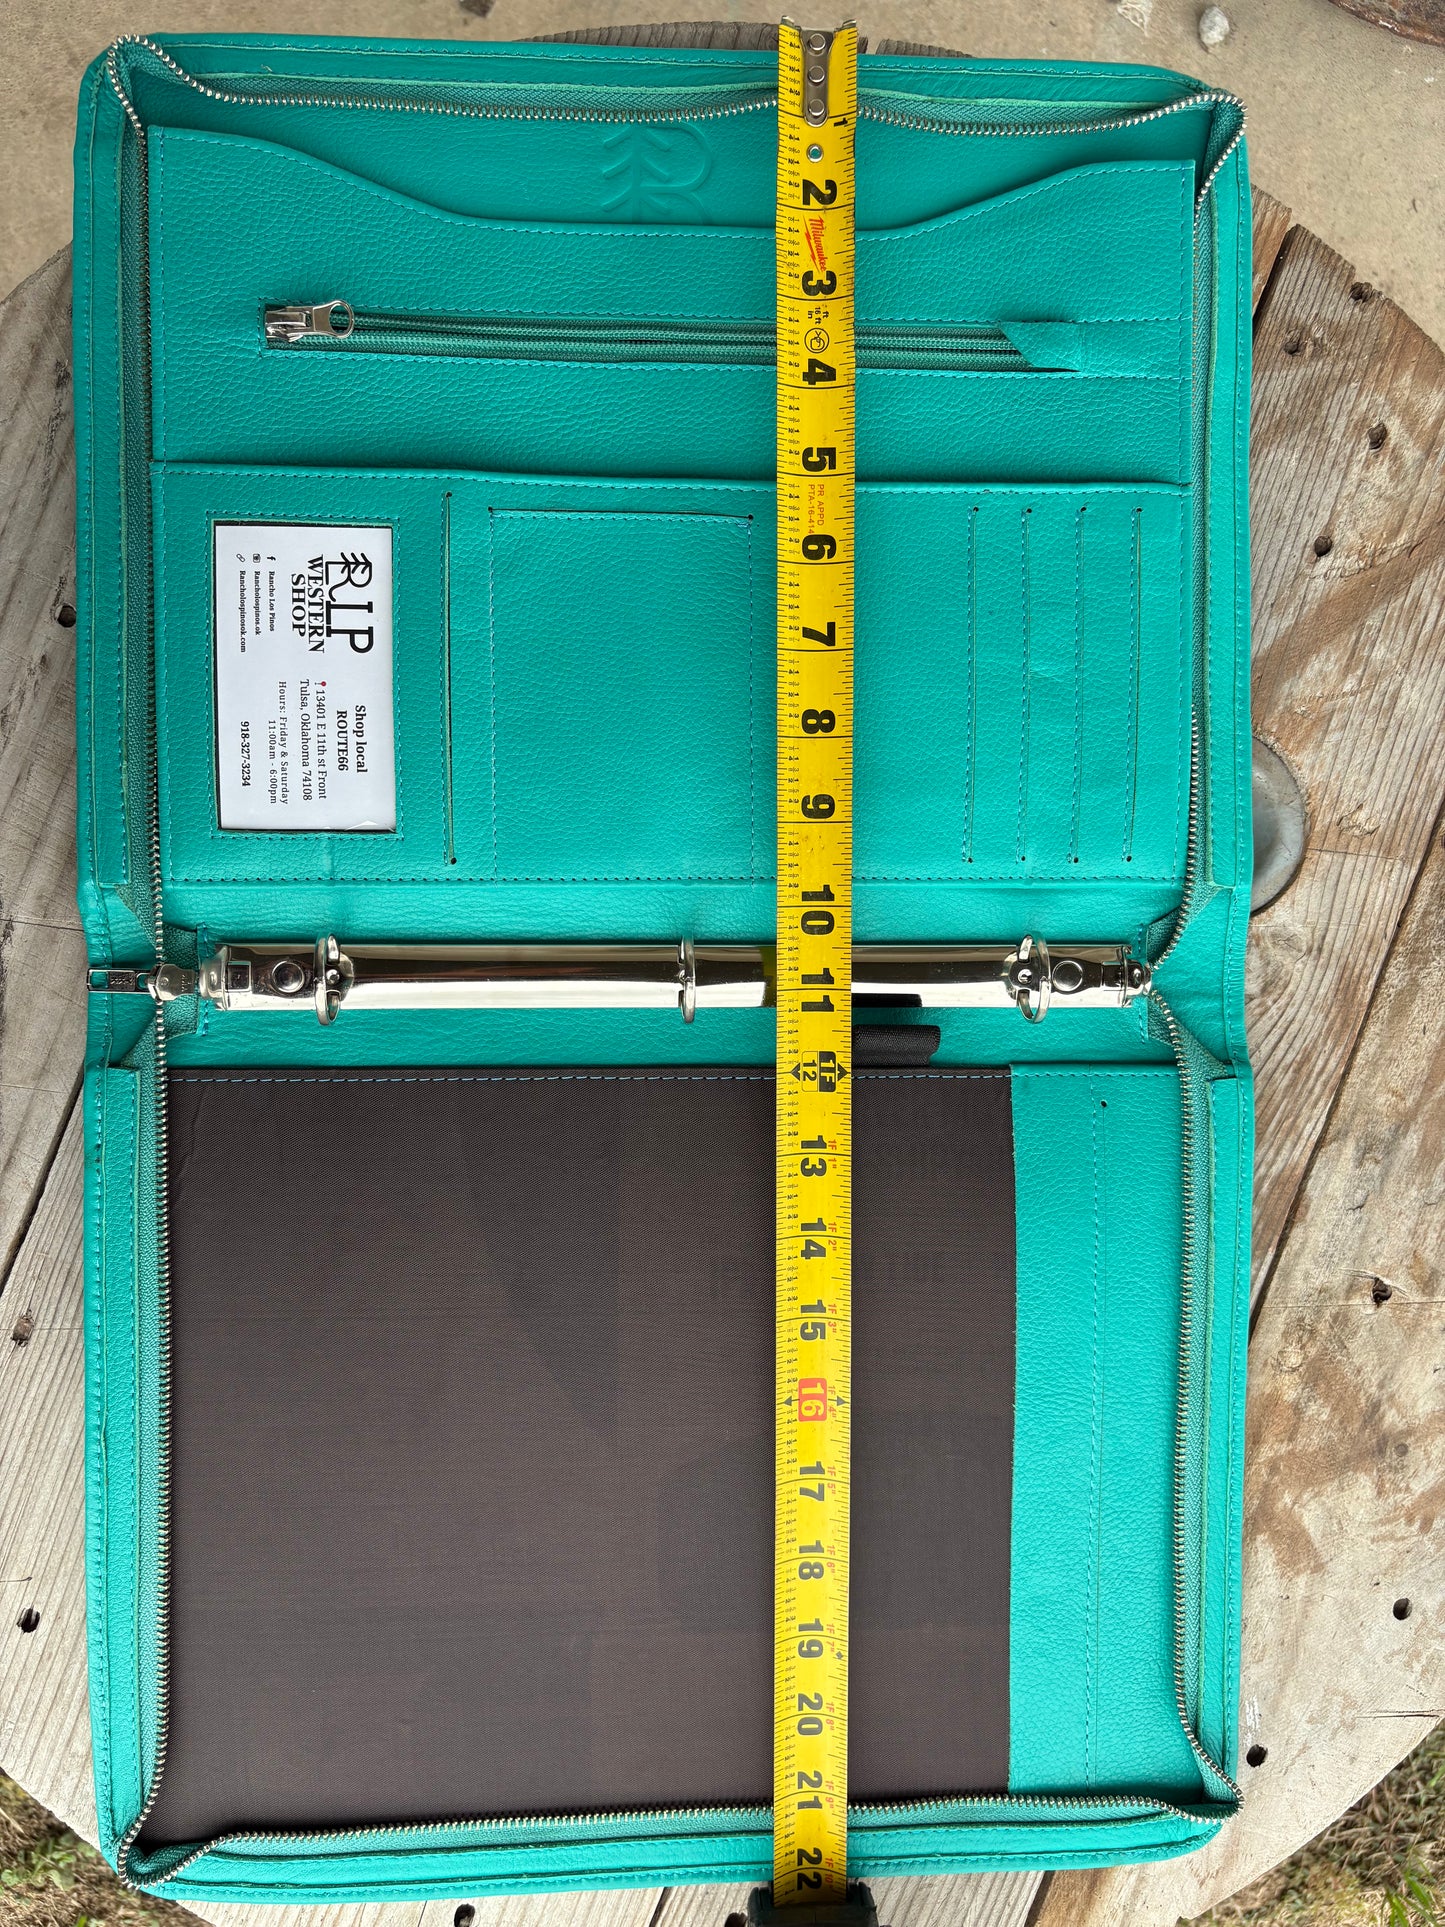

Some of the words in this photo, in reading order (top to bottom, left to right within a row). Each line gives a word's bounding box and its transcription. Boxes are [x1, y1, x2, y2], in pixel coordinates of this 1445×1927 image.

[833, 117, 849, 127] 1
[802, 179, 838, 206] 2
[809, 214, 828, 271] Milwaukee
[801, 270, 837, 296] 3
[802, 358, 837, 385] 4
[801, 447, 837, 472] 5
[817, 484, 825, 497] PR
[816, 500, 825, 526] APPD
[801, 534, 837, 561] 6
[291, 573, 307, 637] SHOP
[307, 554, 325, 653] WESTERN
[802, 621, 836, 647] 7
[298, 679, 310, 711] Tulsa,
[315, 690, 325, 720] 13401
[279, 717, 288, 749] Friday
[354, 705, 367, 739] Shop
[801, 709, 836, 734] 8
[240, 721, 251, 787] 918-327-3234
[267, 720, 276, 760] 11:00am
[300, 713, 312, 767] Oklahoma
[317, 733, 326, 755] 11th
[337, 710, 349, 771] ROUTE66
[355, 741, 368, 773] local
[317, 758, 325, 768] st
[269, 769, 277, 804] 6:00pm
[279, 760, 288, 804] Saturday
[302, 770, 313, 801] 74108
[318, 770, 328, 799] Front
[801, 794, 835, 819] 9
[801, 884, 835, 935] 10
[801, 968, 835, 1012] 11
[803, 1059, 817, 1081] 12
[800, 1135, 827, 1177] 13
[800, 1217, 827, 1260] 14
[799, 1299, 827, 1341] 15
[801, 1382, 825, 1417] 16
[799, 1460, 825, 1501] 17
[798, 1540, 825, 1580] 18
[798, 1618, 824, 1659] 19
[797, 1693, 824, 1736] 20
[797, 1771, 823, 1810] 21
[796, 1847, 823, 1891] 22
